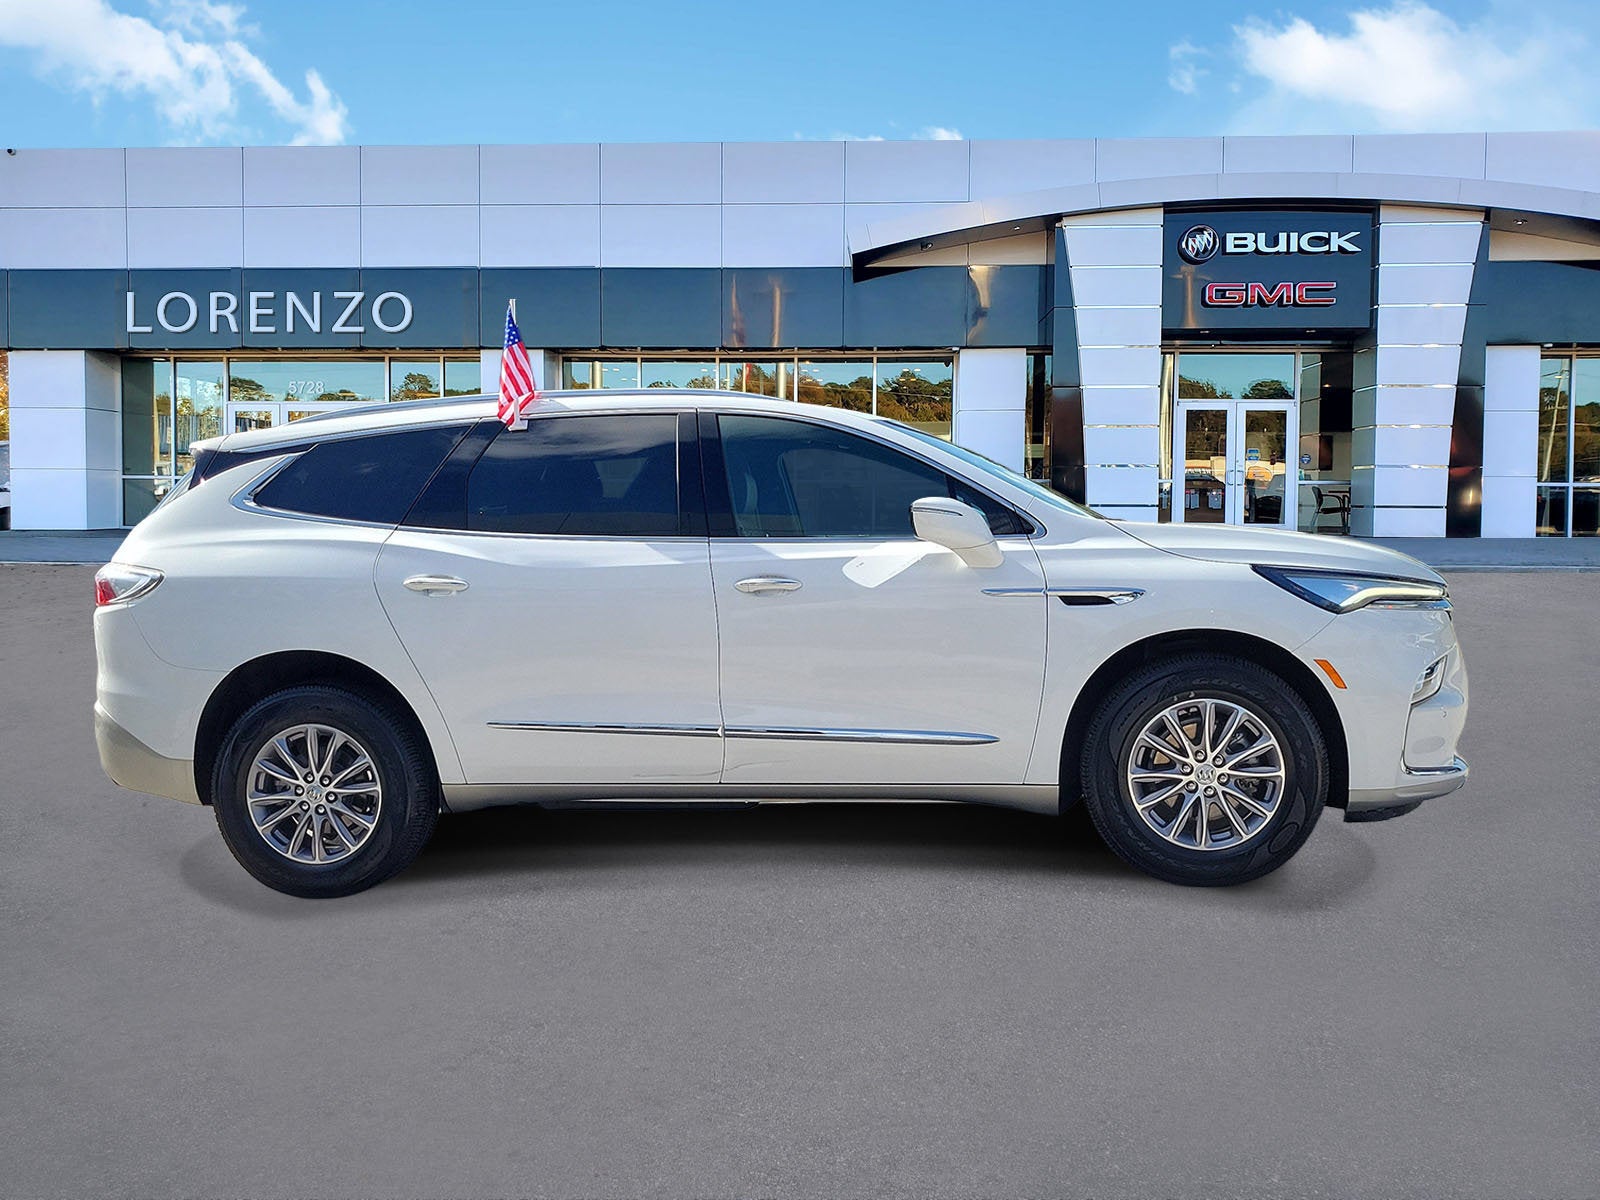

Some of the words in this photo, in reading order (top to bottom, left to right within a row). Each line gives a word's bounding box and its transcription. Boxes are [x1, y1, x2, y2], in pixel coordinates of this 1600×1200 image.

[1225, 231, 1362, 253] BUICK
[1205, 281, 1337, 305] GMC
[126, 291, 413, 333] LORENZO
[288, 380, 325, 394] 5728
